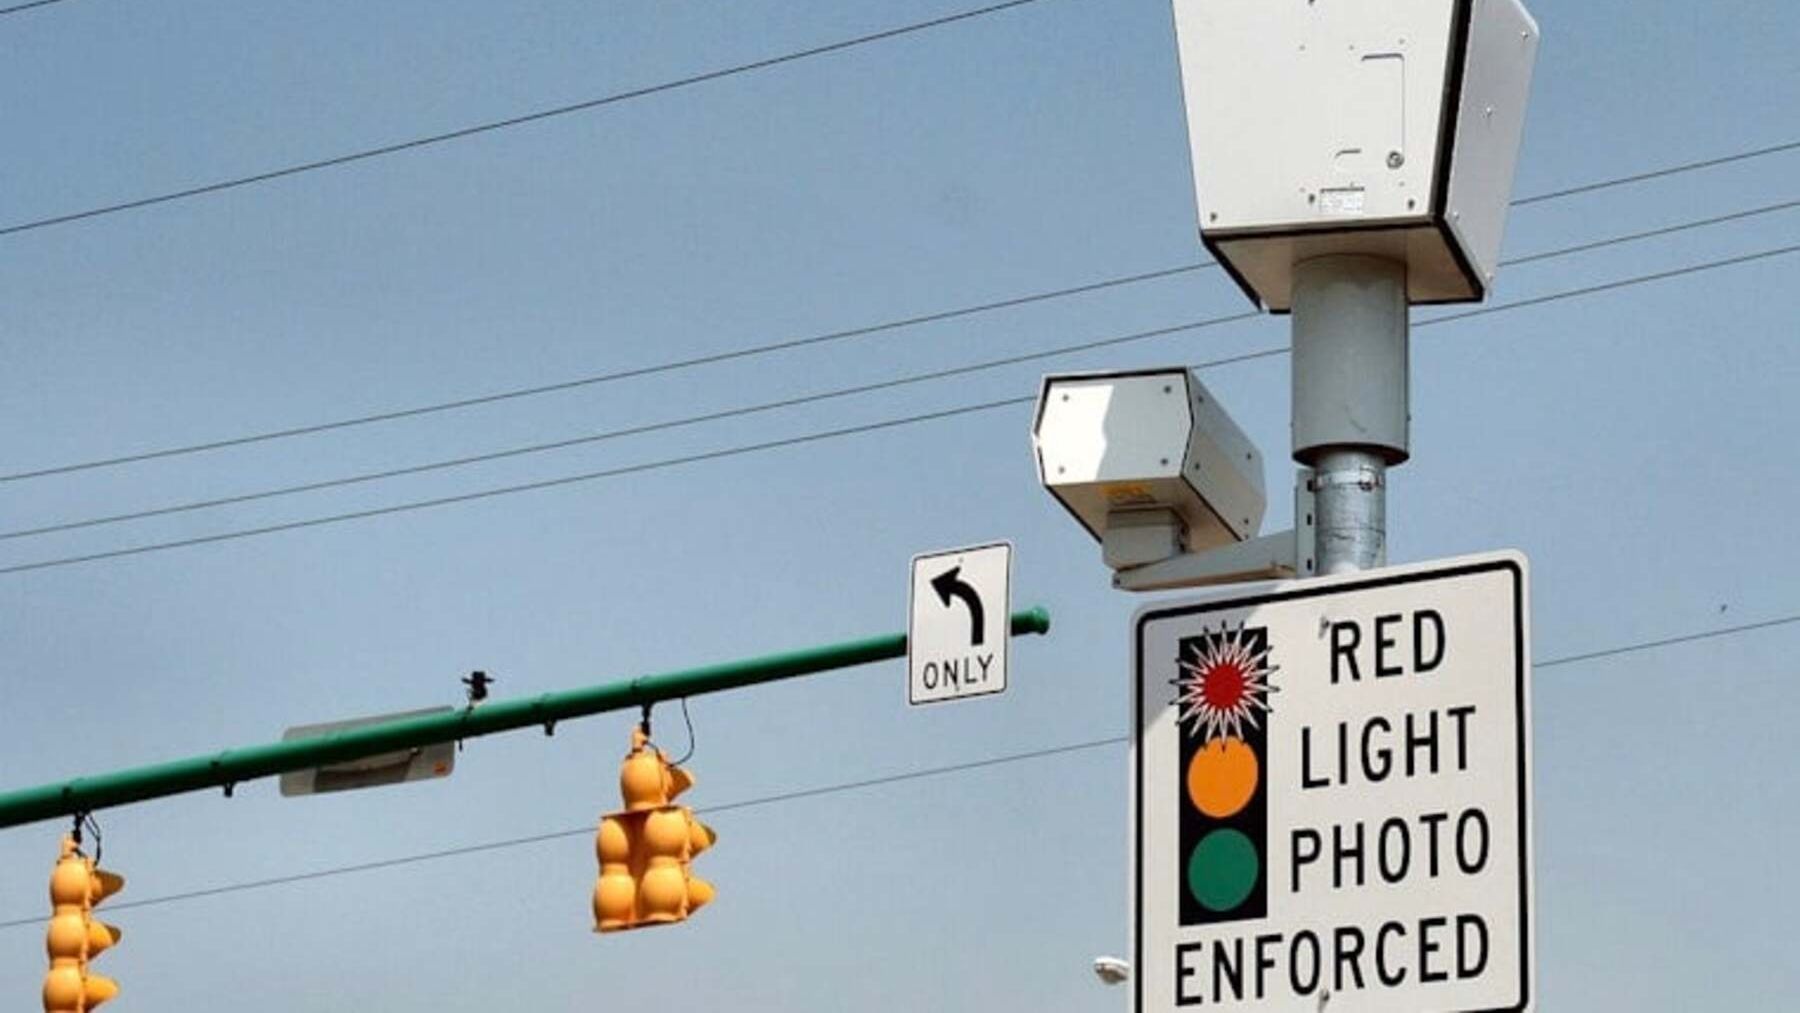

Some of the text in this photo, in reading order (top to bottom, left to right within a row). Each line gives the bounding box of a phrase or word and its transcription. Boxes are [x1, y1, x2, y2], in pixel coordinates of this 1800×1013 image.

[923, 653, 993, 690] ONLY
[1330, 609, 1446, 684] RED
[1301, 705, 1476, 789] LIGHT
[1291, 808, 1490, 893] PHOTO
[1175, 914, 1489, 1007] ENFORCED
